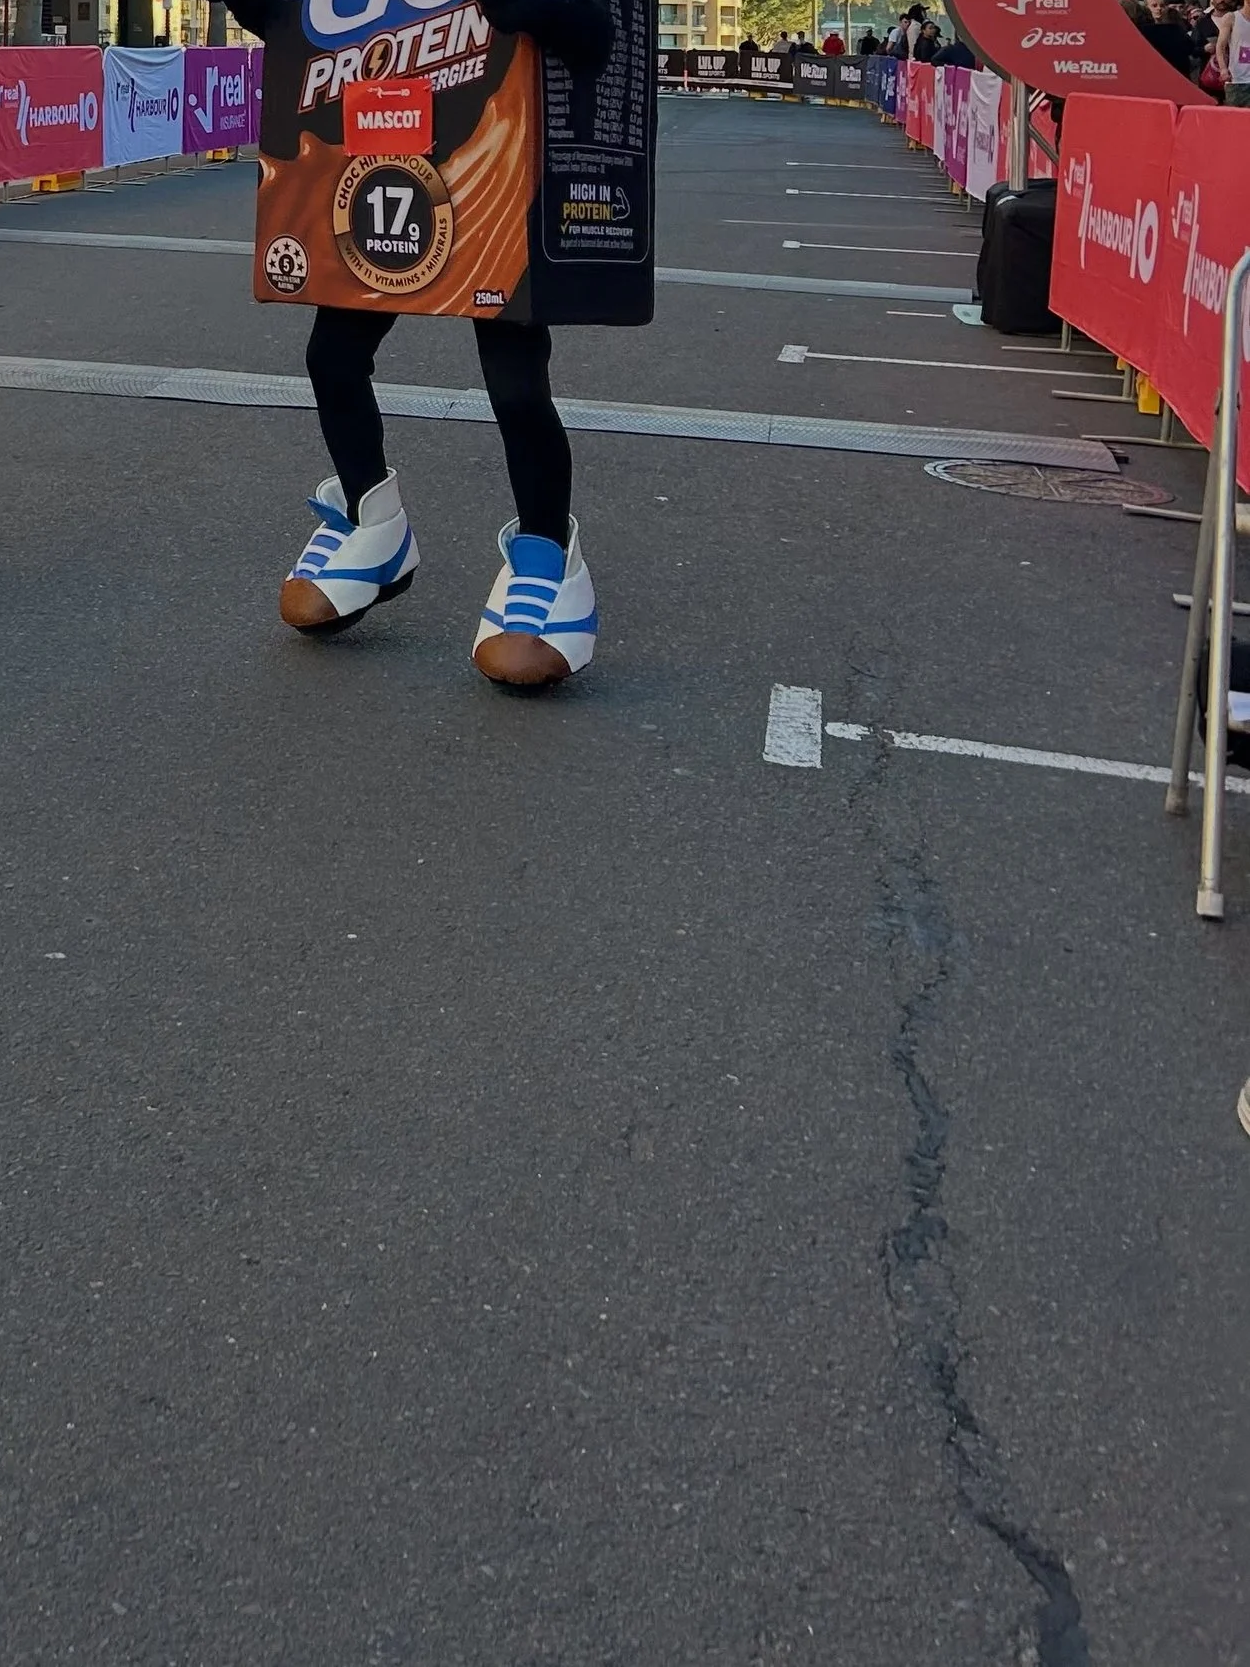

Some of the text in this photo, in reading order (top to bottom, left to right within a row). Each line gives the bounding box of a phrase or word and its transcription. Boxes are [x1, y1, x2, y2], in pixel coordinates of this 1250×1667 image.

[301, 4, 490, 108] PROTEIN
[1053, 60, 1118, 74] WeRun
[220, 64, 245, 107] real
[418, 53, 487, 92] ERGIZE
[4, 85, 19, 101] real
[29, 91, 98, 132] HARBOUR 10
[356, 109, 422, 130] MASCOT
[338, 166, 360, 210] CHOC
[570, 183, 610, 202] HIGH IN
[562, 202, 610, 221] PROTEIN
[366, 238, 419, 254] PROTEIN
[375, 272, 420, 287] VITAMINS
[426, 217, 448, 274] MINERALS
[1088, 198, 1159, 284] HARBOUR 10
[283, 258, 291, 272] 5
[475, 292, 505, 304] 250mL
[1191, 251, 1230, 316] HARBO
